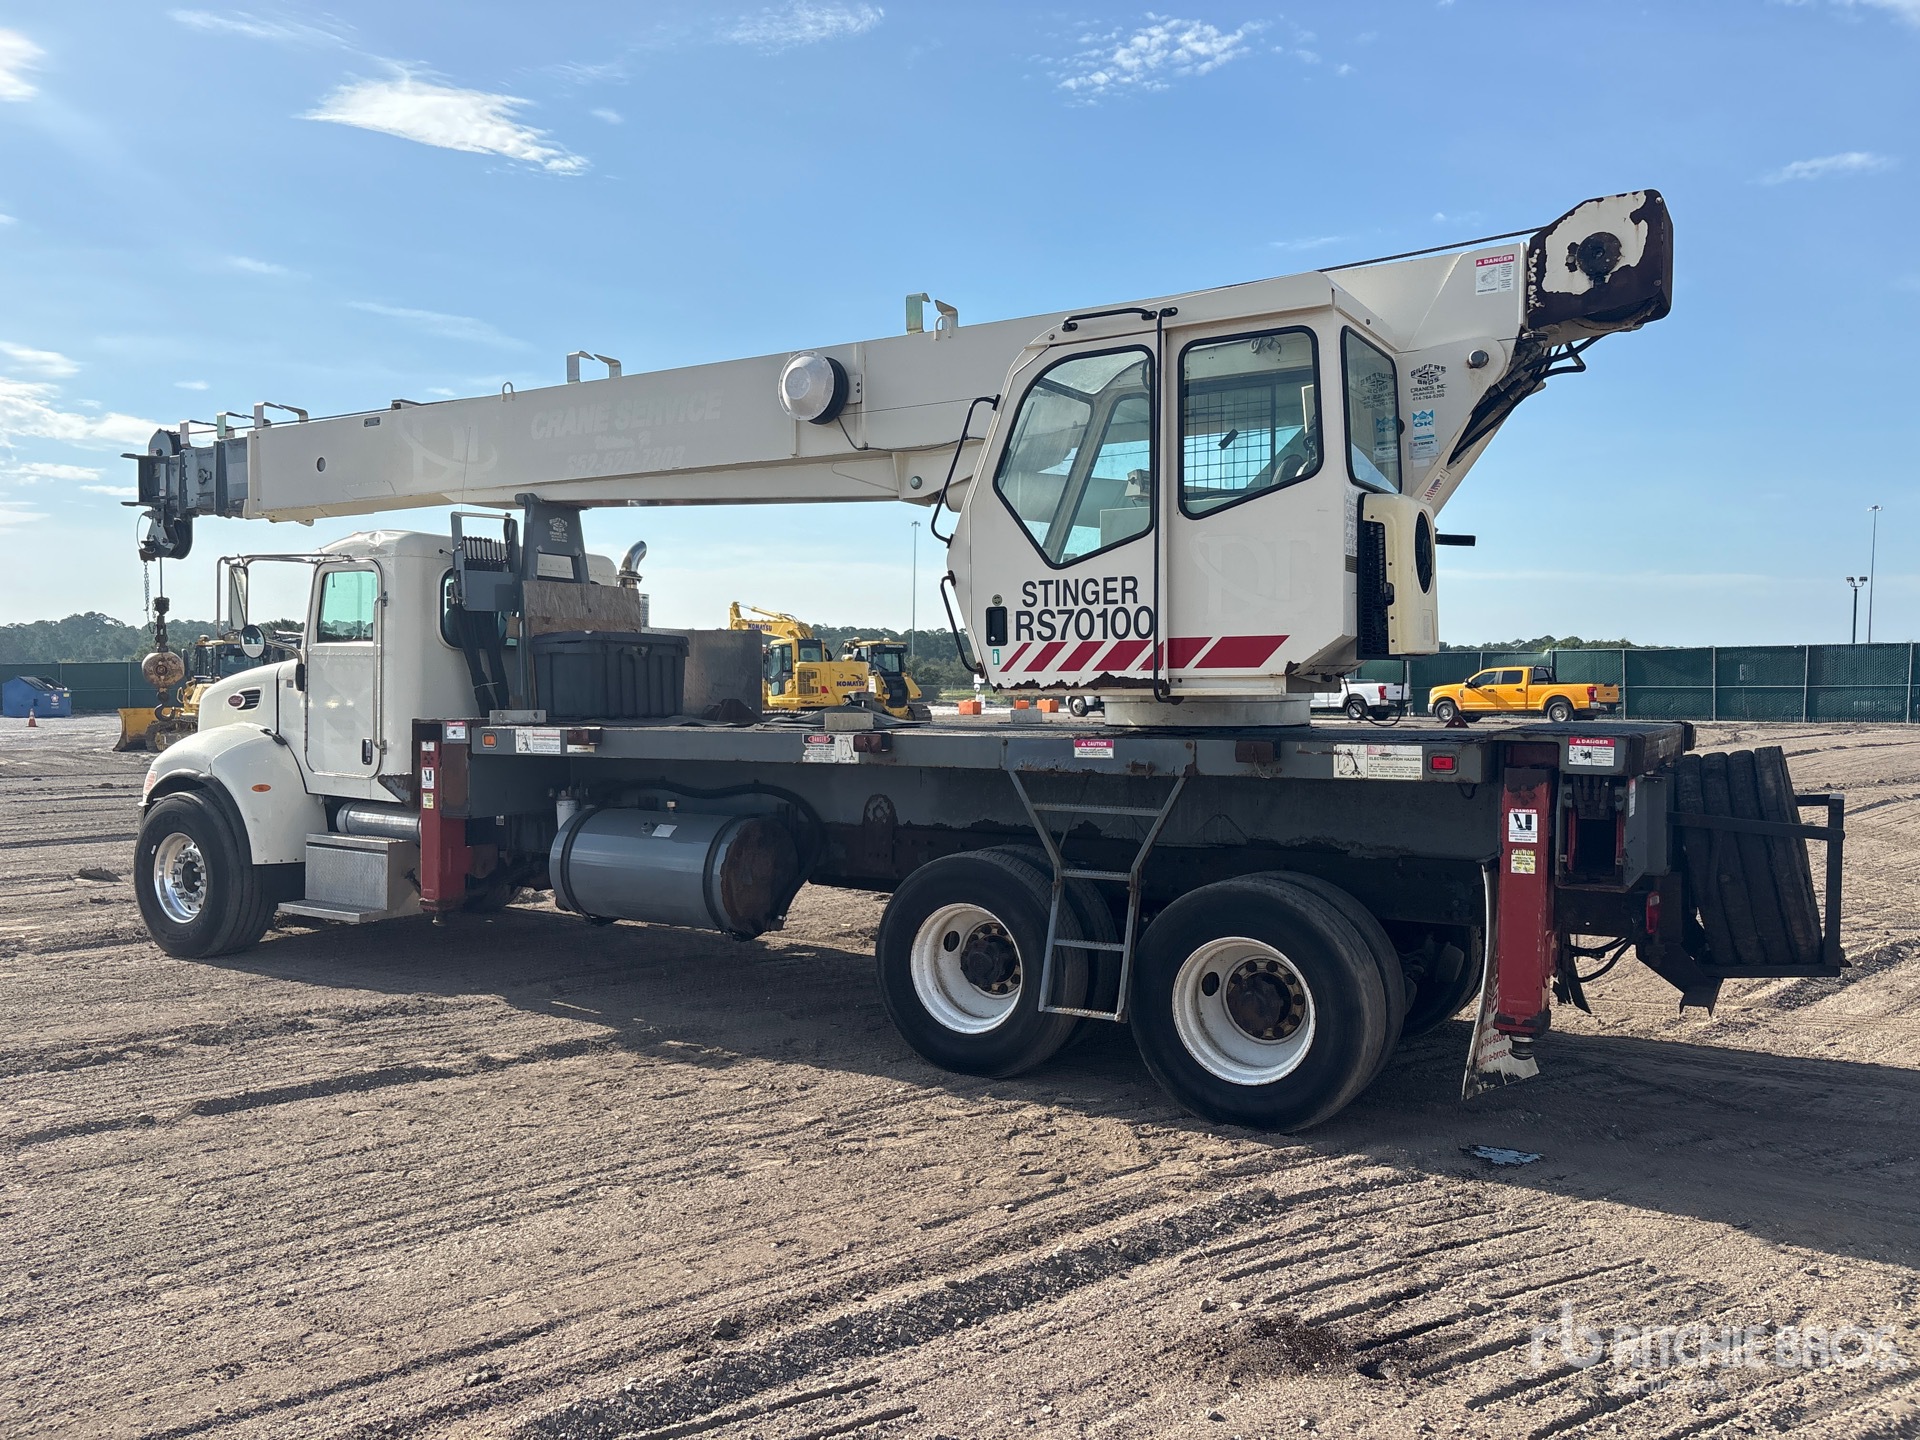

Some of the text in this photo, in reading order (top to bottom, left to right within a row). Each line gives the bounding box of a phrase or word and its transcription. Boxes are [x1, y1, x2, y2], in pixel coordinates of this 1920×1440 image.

[1483, 255, 1514, 265] DANGER
[1410, 363, 1447, 377] GIUFFRE
[530, 401, 612, 441] CRANE
[614, 389, 725, 430] SERVICE
[1414, 420, 1433, 428] OK
[1021, 575, 1139, 609] STINGER
[747, 622, 773, 632] KOMATSU
[1015, 605, 1155, 641] RS70100
